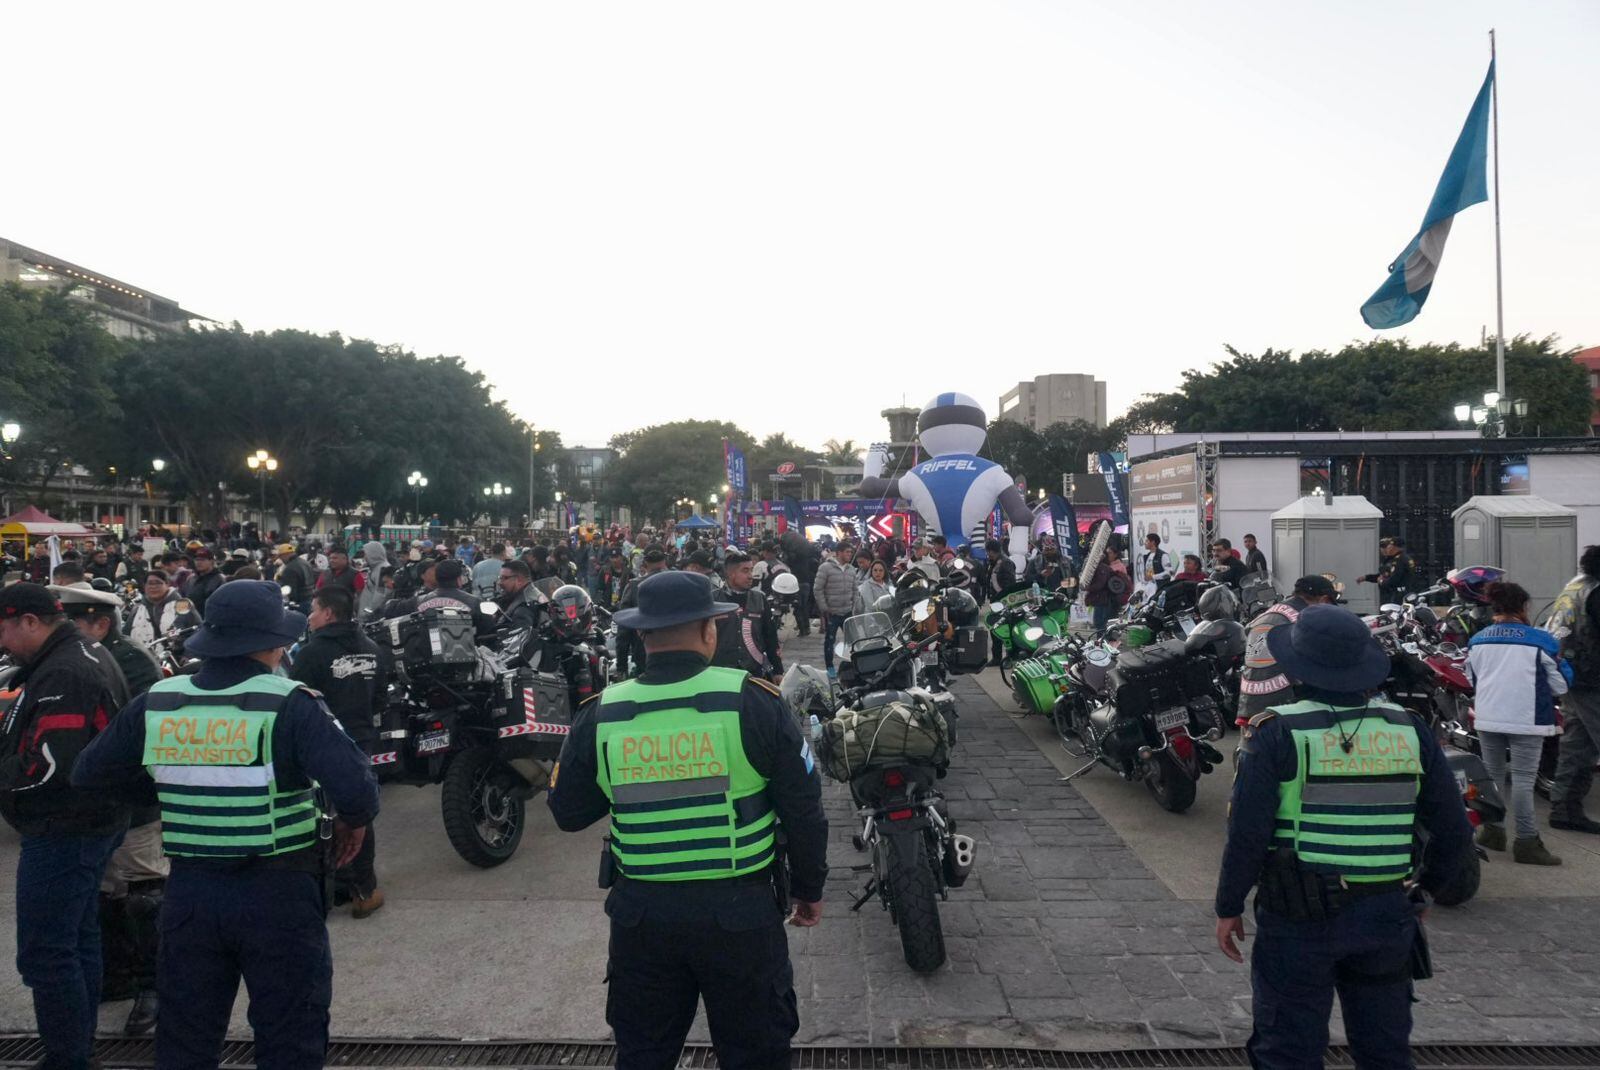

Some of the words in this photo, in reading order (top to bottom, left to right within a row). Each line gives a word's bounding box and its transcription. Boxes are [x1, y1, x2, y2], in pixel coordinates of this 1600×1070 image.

[920, 459, 977, 475] RIFFEL
[1104, 466, 1122, 513] RIFFEL
[819, 504, 838, 512] TVS
[160, 717, 248, 746] POLICIA
[152, 747, 252, 763] TRANSITO
[622, 730, 716, 764] POLICIA
[617, 761, 724, 781] TRANSITO
[1318, 758, 1420, 775] TRANSITO
